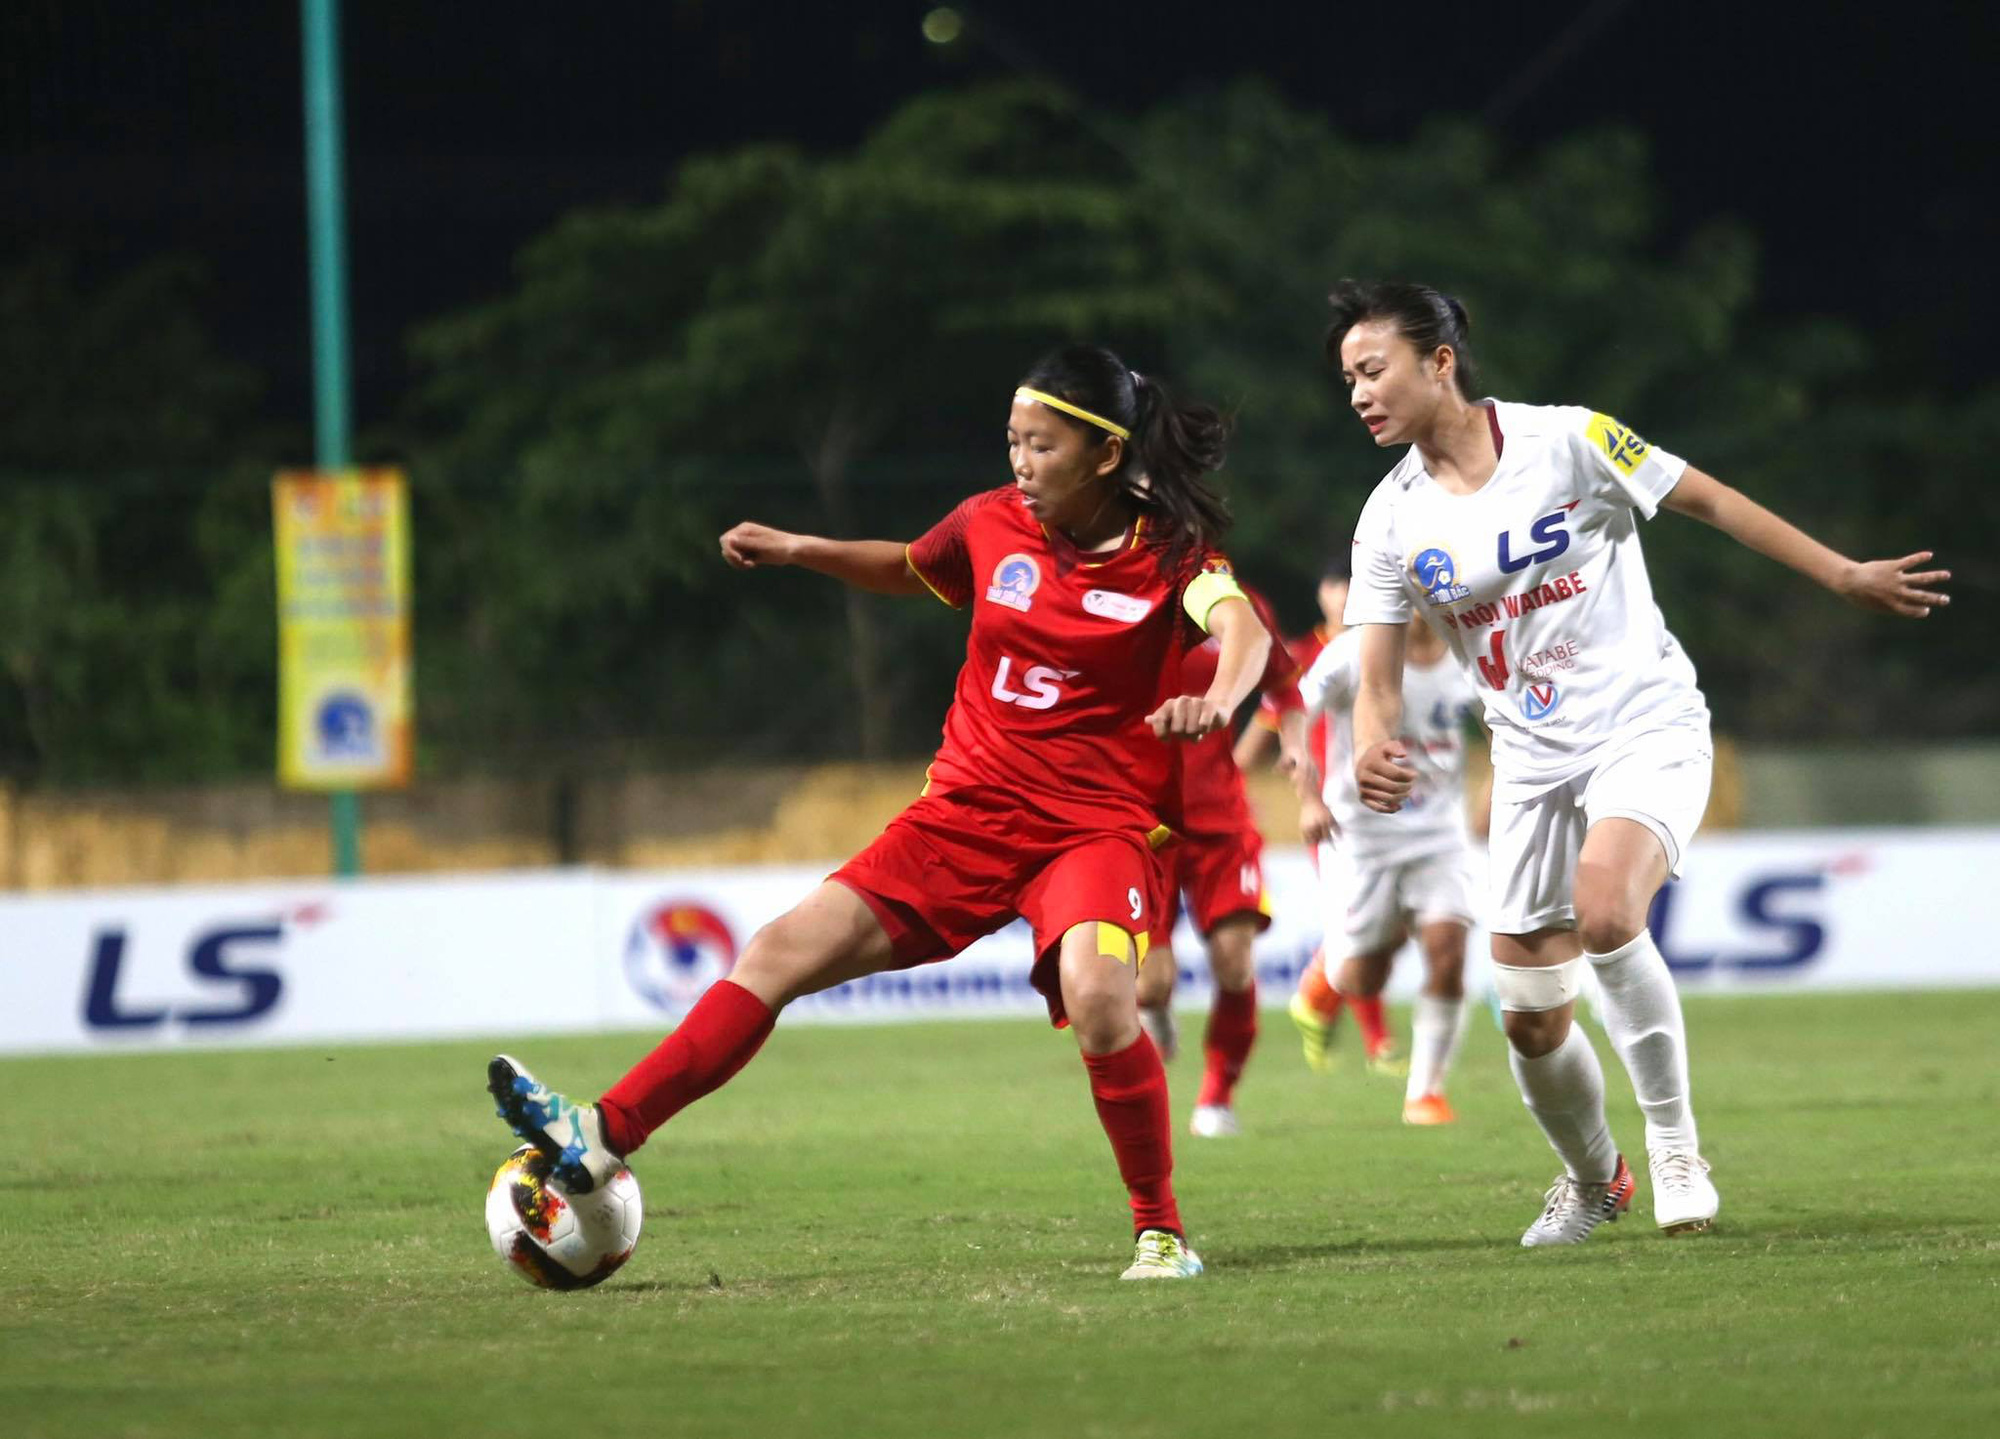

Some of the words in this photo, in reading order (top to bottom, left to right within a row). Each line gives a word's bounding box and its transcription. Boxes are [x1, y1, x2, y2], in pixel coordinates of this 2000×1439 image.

[1497, 510, 1571, 575] LS
[1457, 601, 1500, 629] NỘI
[1501, 571, 1587, 619] WATABE
[991, 656, 1061, 711] LS
[1529, 659, 1575, 680] EDDING
[1128, 886, 1143, 920] 9
[1647, 871, 1826, 971] LS
[82, 919, 285, 1031] LS
